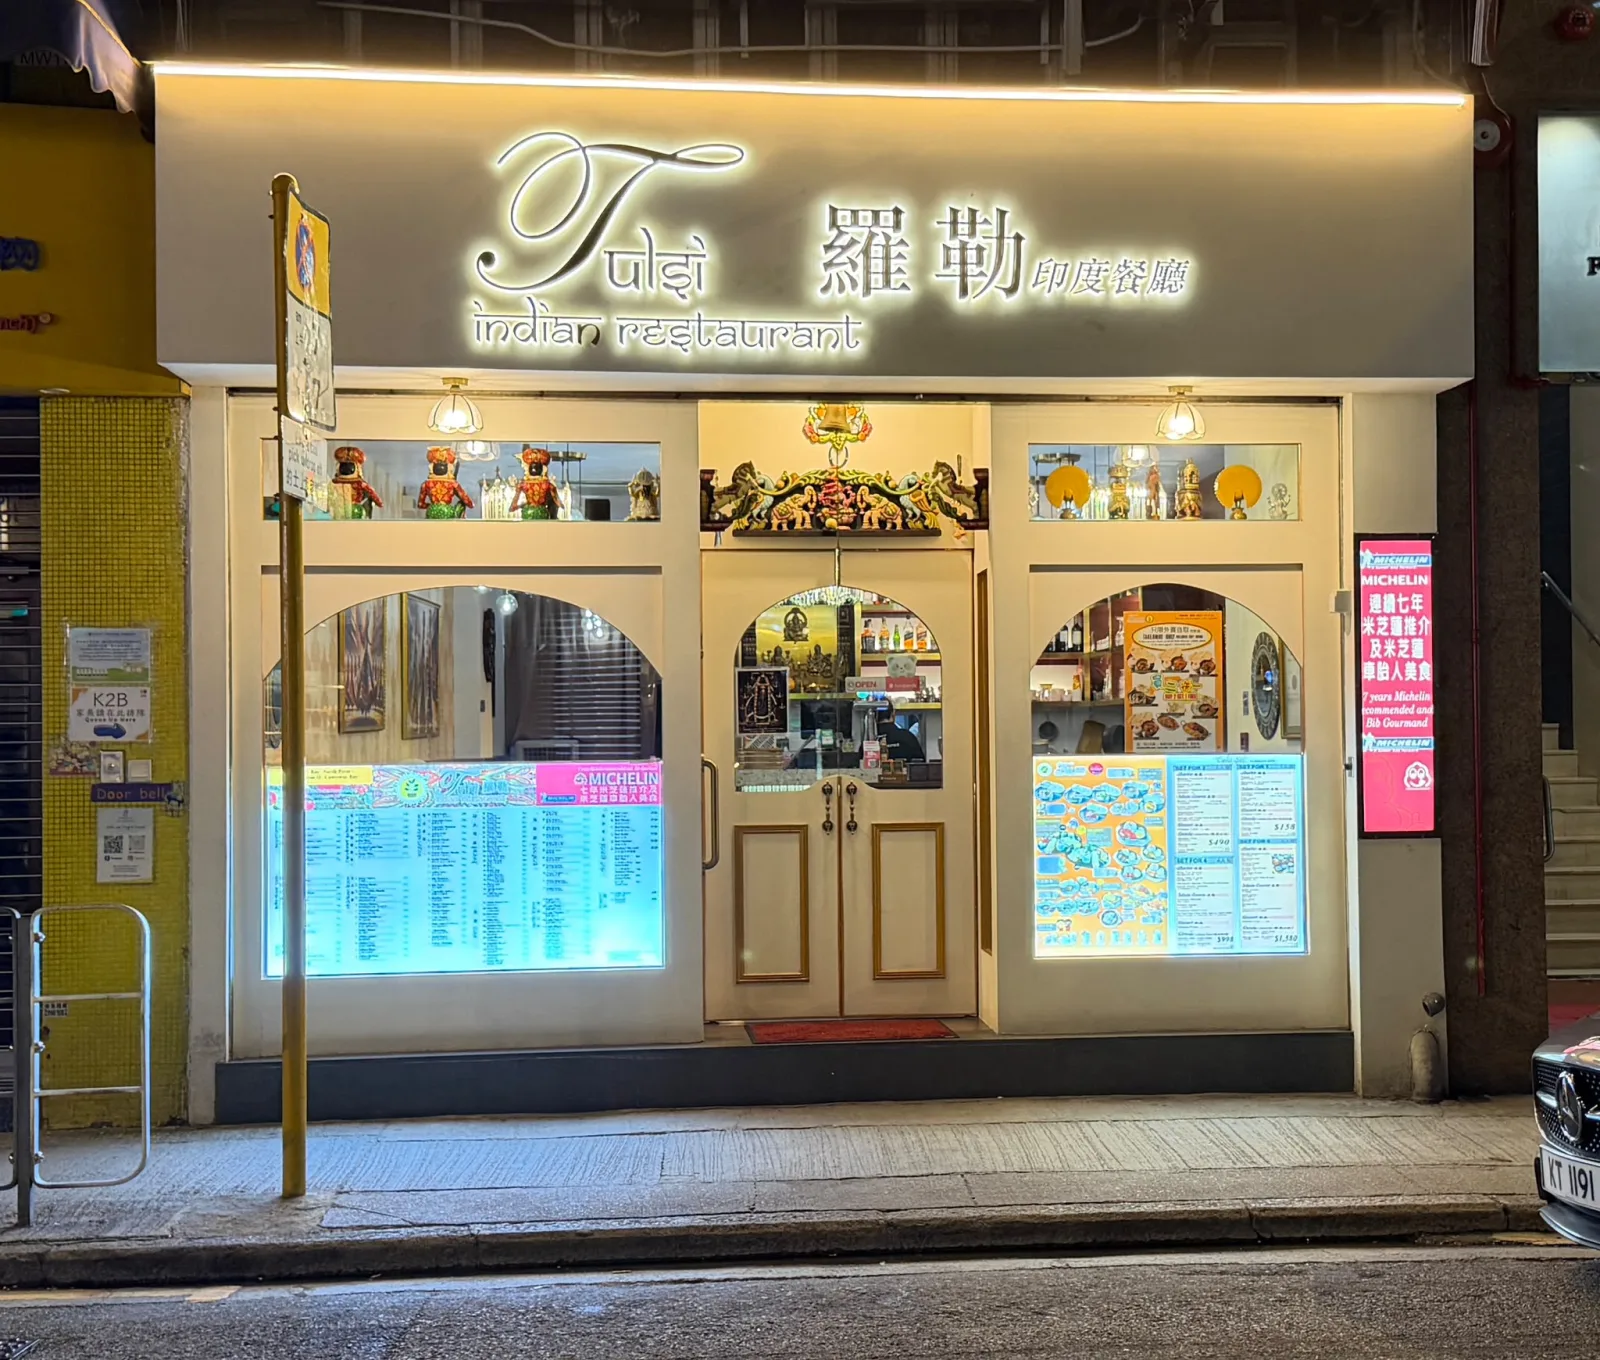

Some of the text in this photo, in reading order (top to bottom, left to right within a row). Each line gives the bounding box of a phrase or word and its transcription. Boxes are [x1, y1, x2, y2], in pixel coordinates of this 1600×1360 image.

[476, 131, 744, 300] Tulsi
[819, 204, 1190, 300] 羅勒 印度餐廳
[473, 297, 862, 352] indian restaurant
[1374, 556, 1429, 564] MICHELIN
[1361, 574, 1429, 586] MICHELIN
[855, 680, 877, 688] OPEN
[93, 692, 128, 707] K2B
[1369, 693, 1392, 704] years
[1394, 690, 1431, 702] Michelin
[1416, 704, 1434, 715] and
[1366, 717, 1429, 728] Bib Gourmand
[1376, 739, 1431, 747] MICHELIN
[589, 771, 659, 785] MICHELIN
[96, 787, 165, 800] Door bell
[1547, 1156, 1595, 1201] KT 1191
